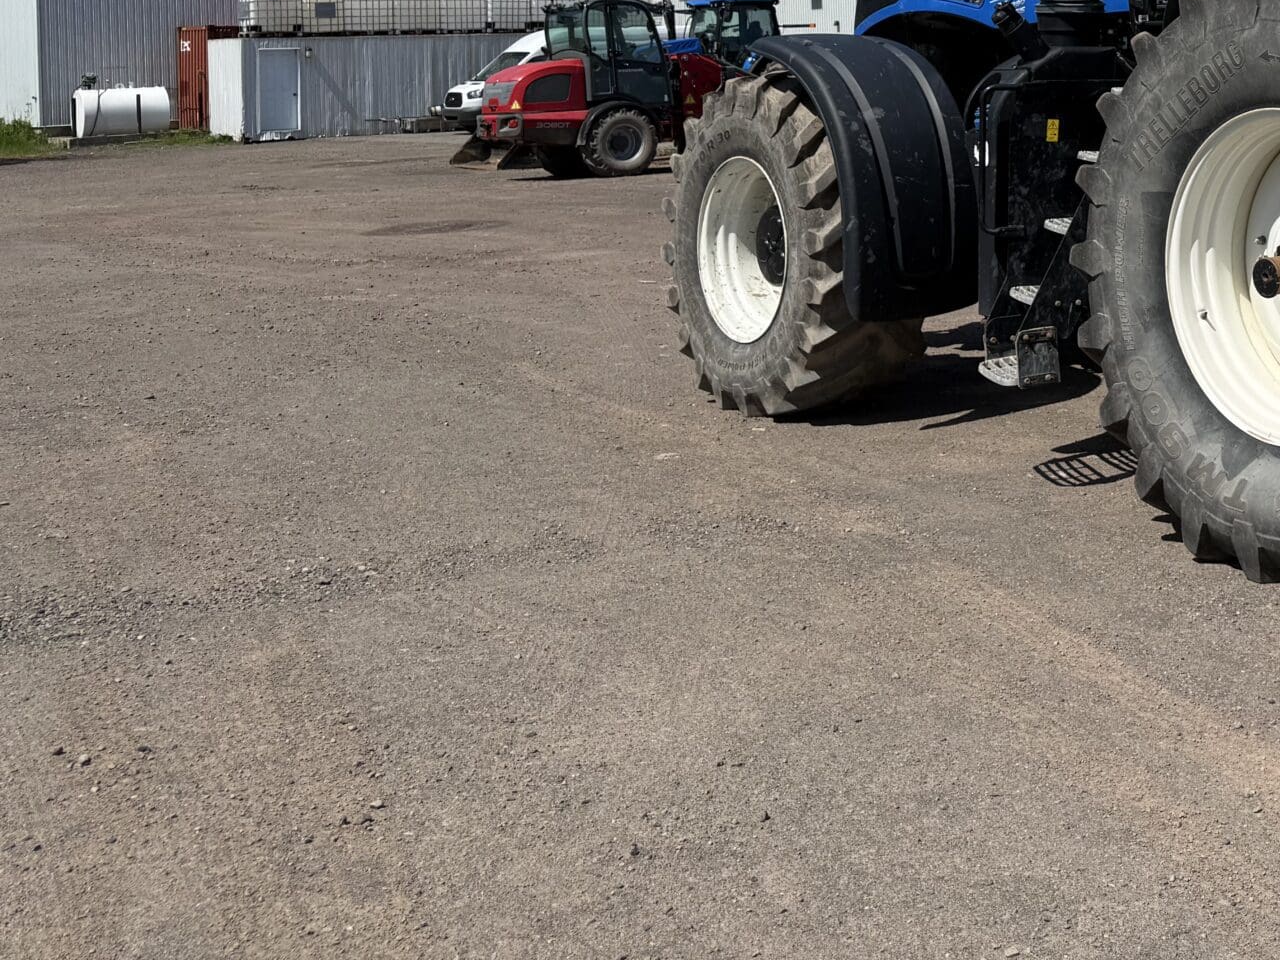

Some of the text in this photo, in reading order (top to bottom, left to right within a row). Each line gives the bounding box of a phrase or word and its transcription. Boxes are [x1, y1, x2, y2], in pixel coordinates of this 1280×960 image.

[1124, 40, 1247, 172] TRELLEBORG
[1114, 196, 1136, 352] HIGH POWER
